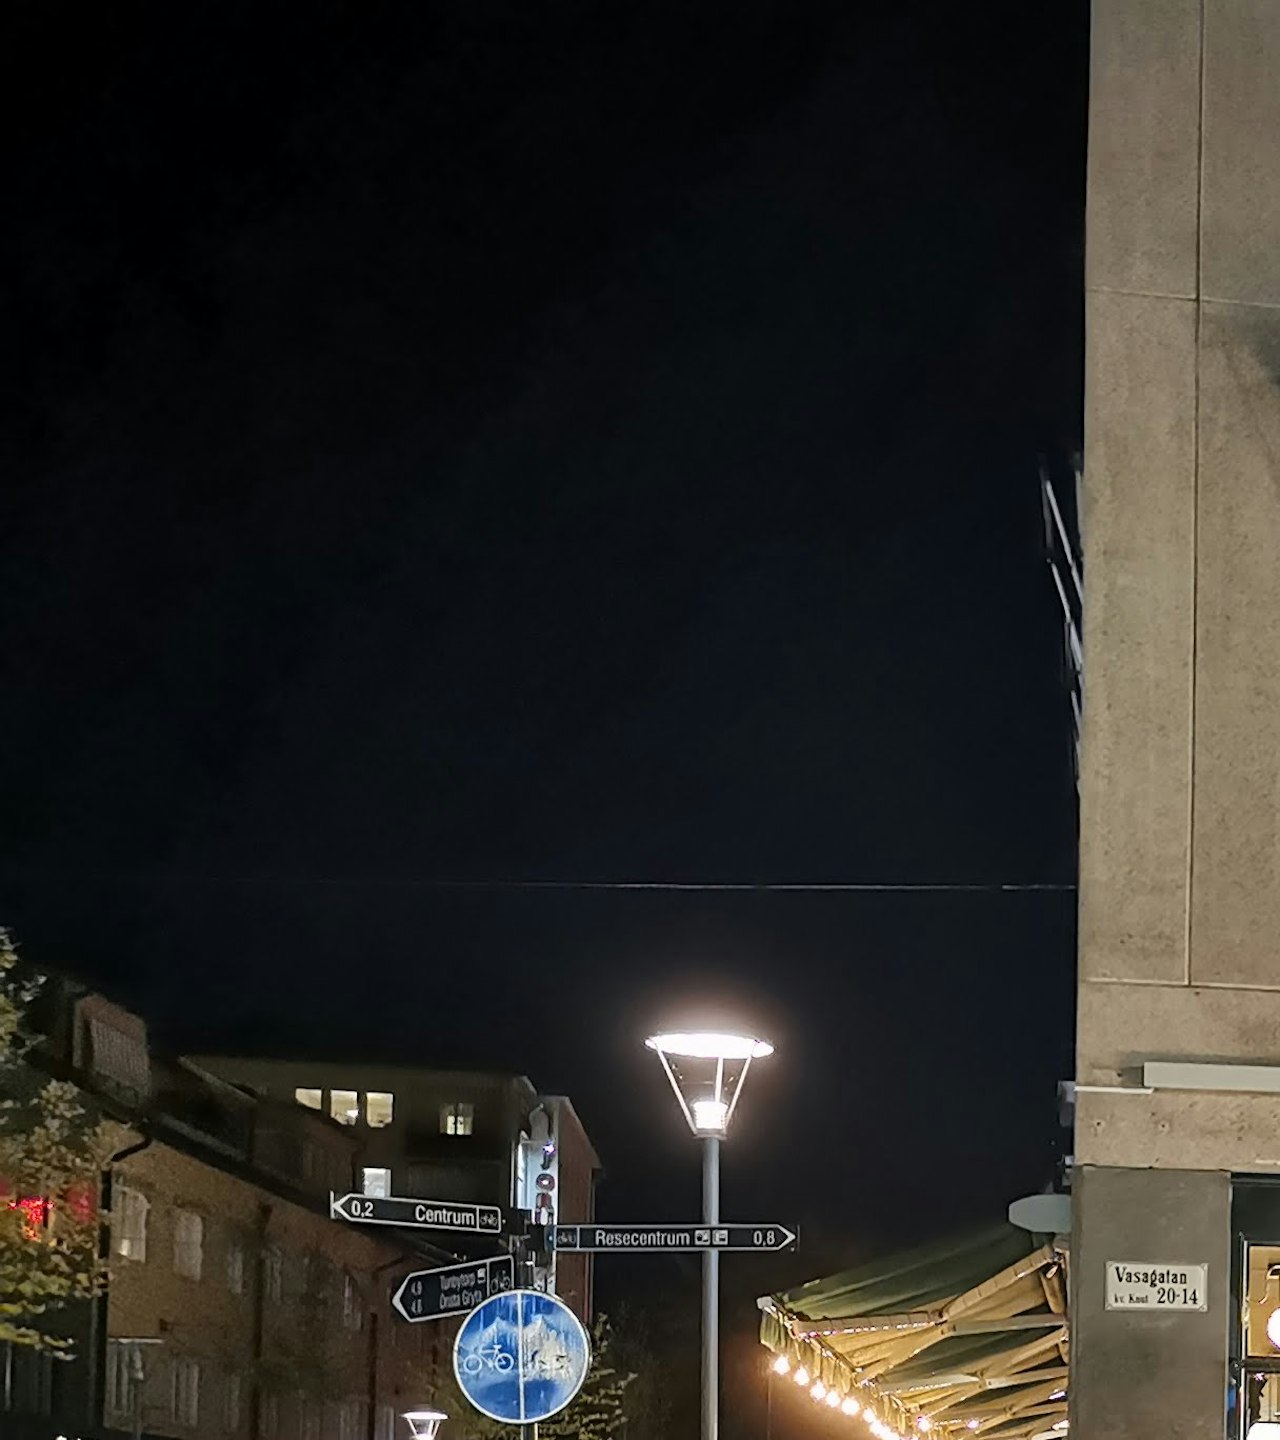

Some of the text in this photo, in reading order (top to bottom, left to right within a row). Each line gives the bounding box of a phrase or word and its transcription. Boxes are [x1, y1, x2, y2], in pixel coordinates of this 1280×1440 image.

[351, 1201, 475, 1226] 0,2 Centrum
[595, 1229, 776, 1247] Resecentrum 0,8
[1115, 1266, 1188, 1288] Vasagatan
[1157, 1287, 1198, 1305] 20-14
